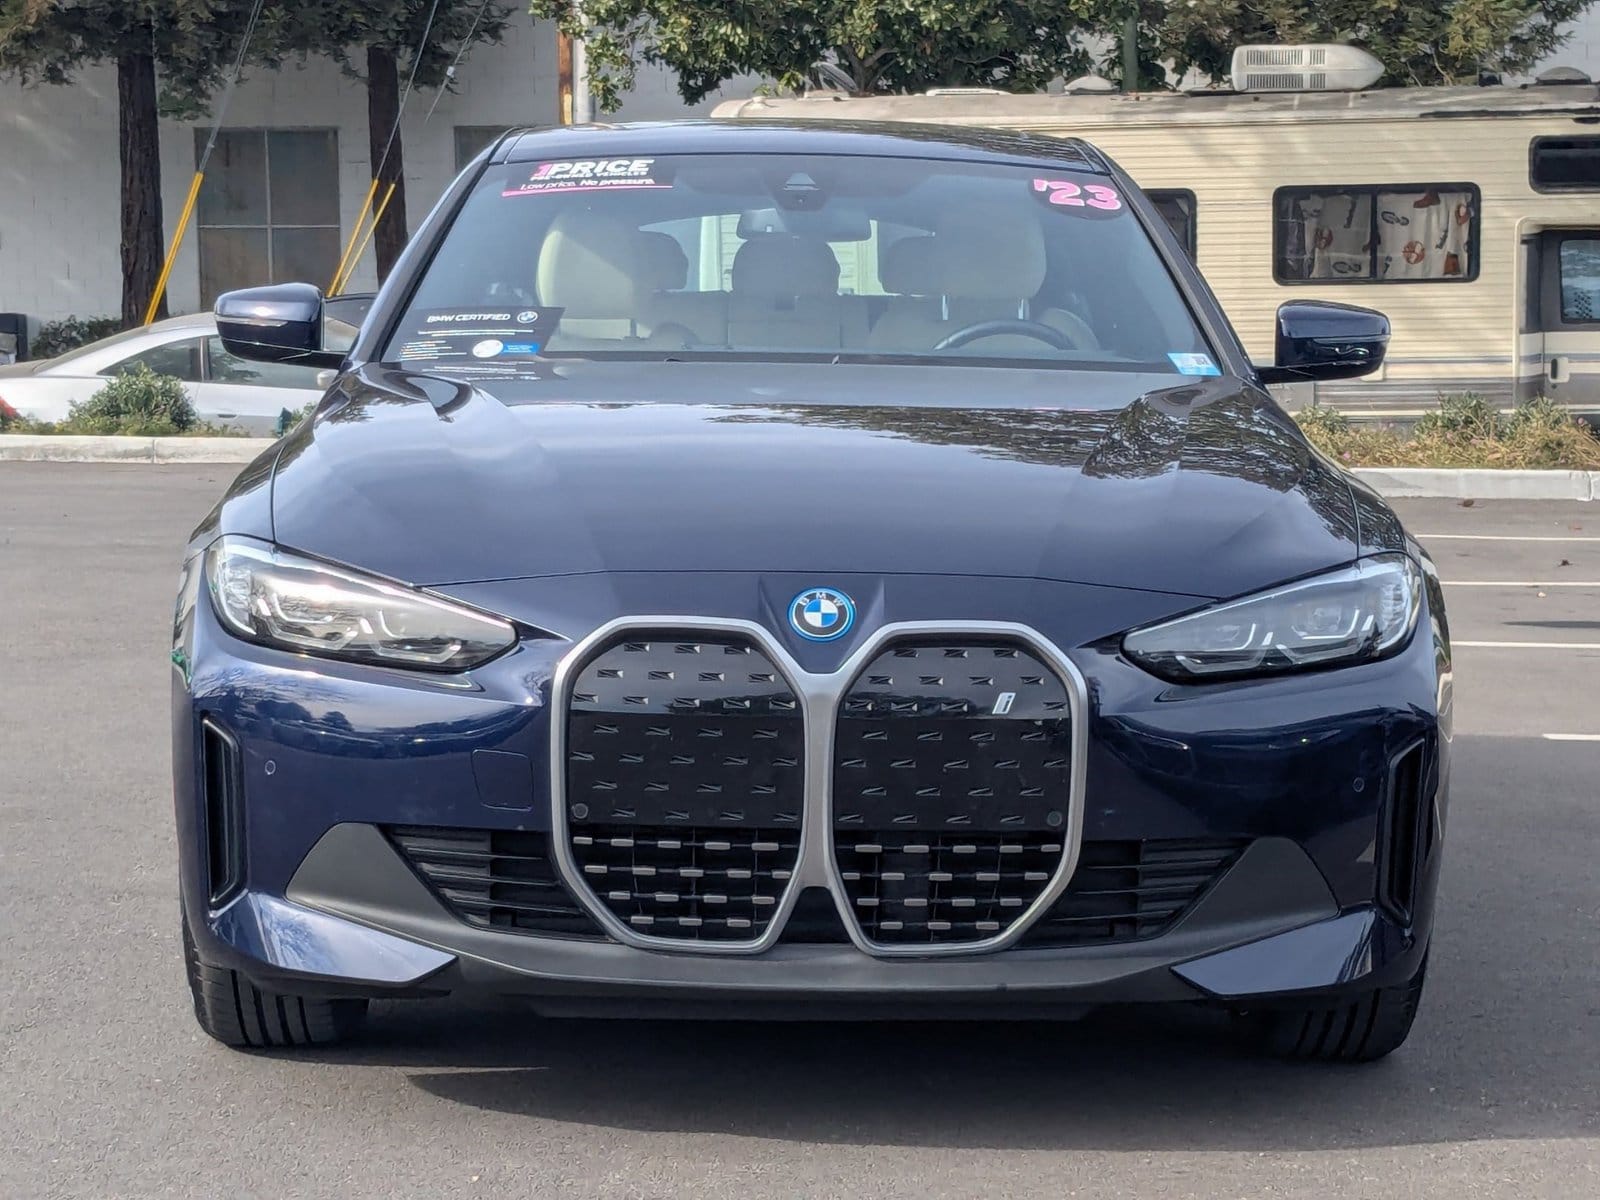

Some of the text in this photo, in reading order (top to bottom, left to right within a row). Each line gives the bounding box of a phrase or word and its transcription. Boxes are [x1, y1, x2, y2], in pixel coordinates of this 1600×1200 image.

[580, 179, 598, 187] No
[427, 314, 455, 323] BMW
[455, 313, 511, 321] CERTIFIED
[799, 591, 845, 606] BMW
